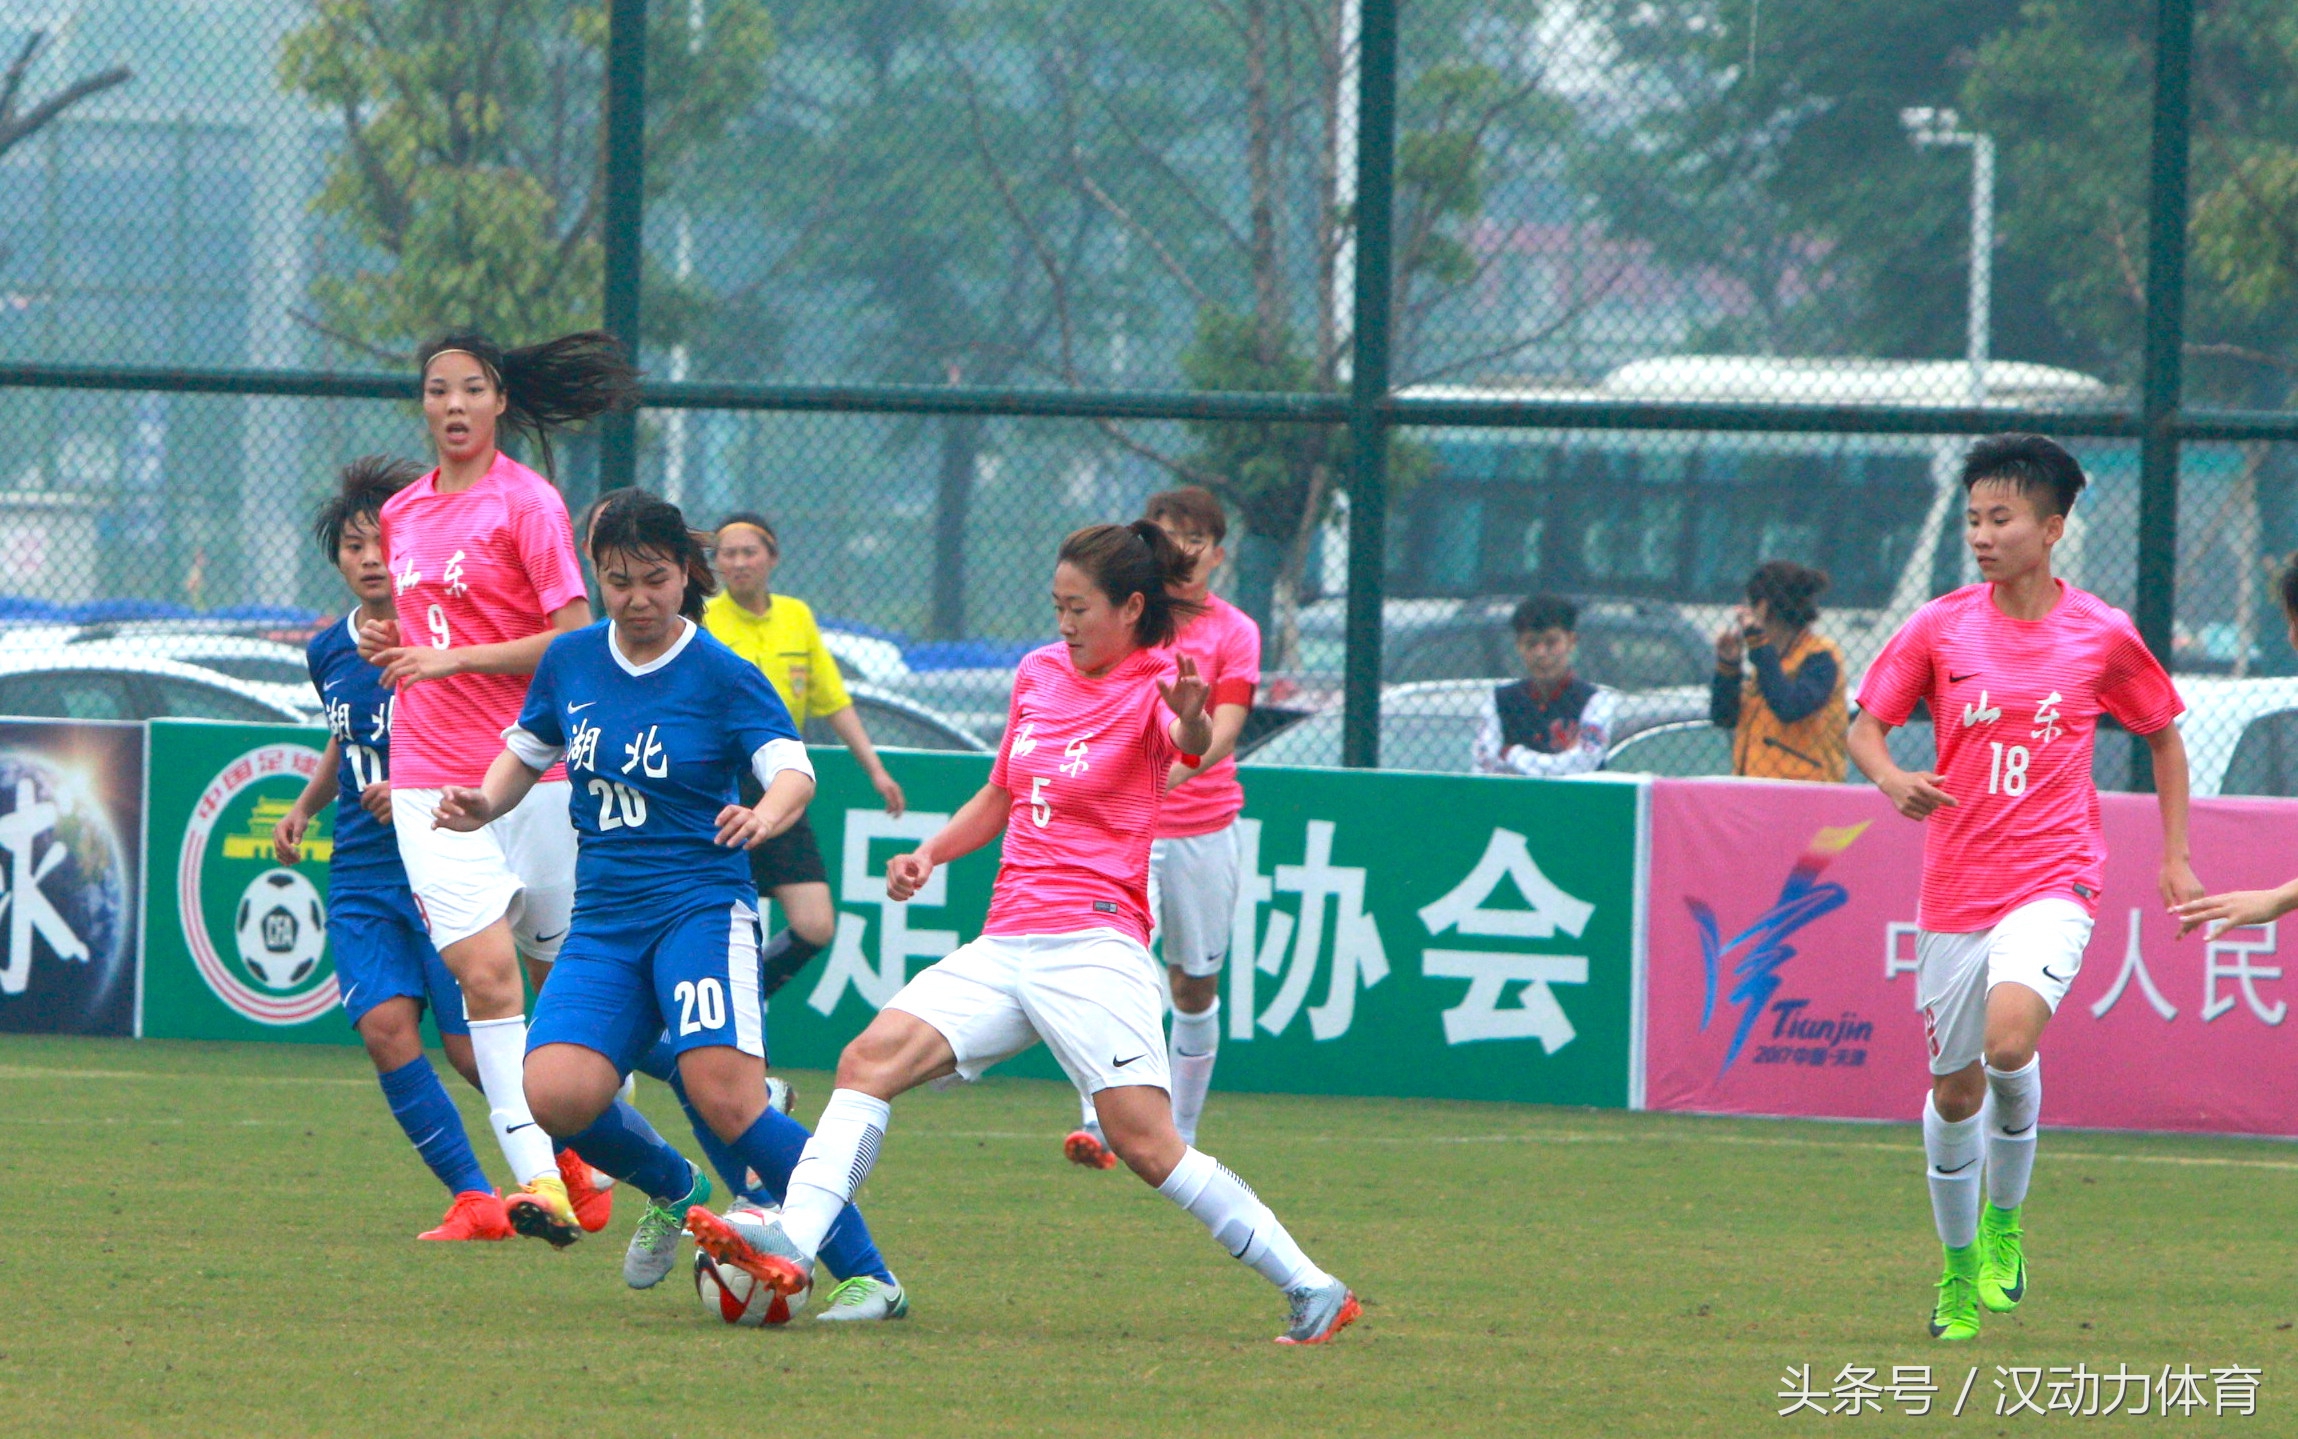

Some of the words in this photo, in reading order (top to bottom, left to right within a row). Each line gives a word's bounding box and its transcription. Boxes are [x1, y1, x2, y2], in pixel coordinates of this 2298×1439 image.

[428, 603, 450, 650] 9
[1963, 689, 2063, 744] 山东
[566, 718, 668, 779] 湖北
[1988, 741, 2030, 797] 18
[587, 778, 647, 832] 20
[1031, 776, 1051, 828] 5
[674, 977, 726, 1037] 20
[1771, 998, 1873, 1047] Tianjin
